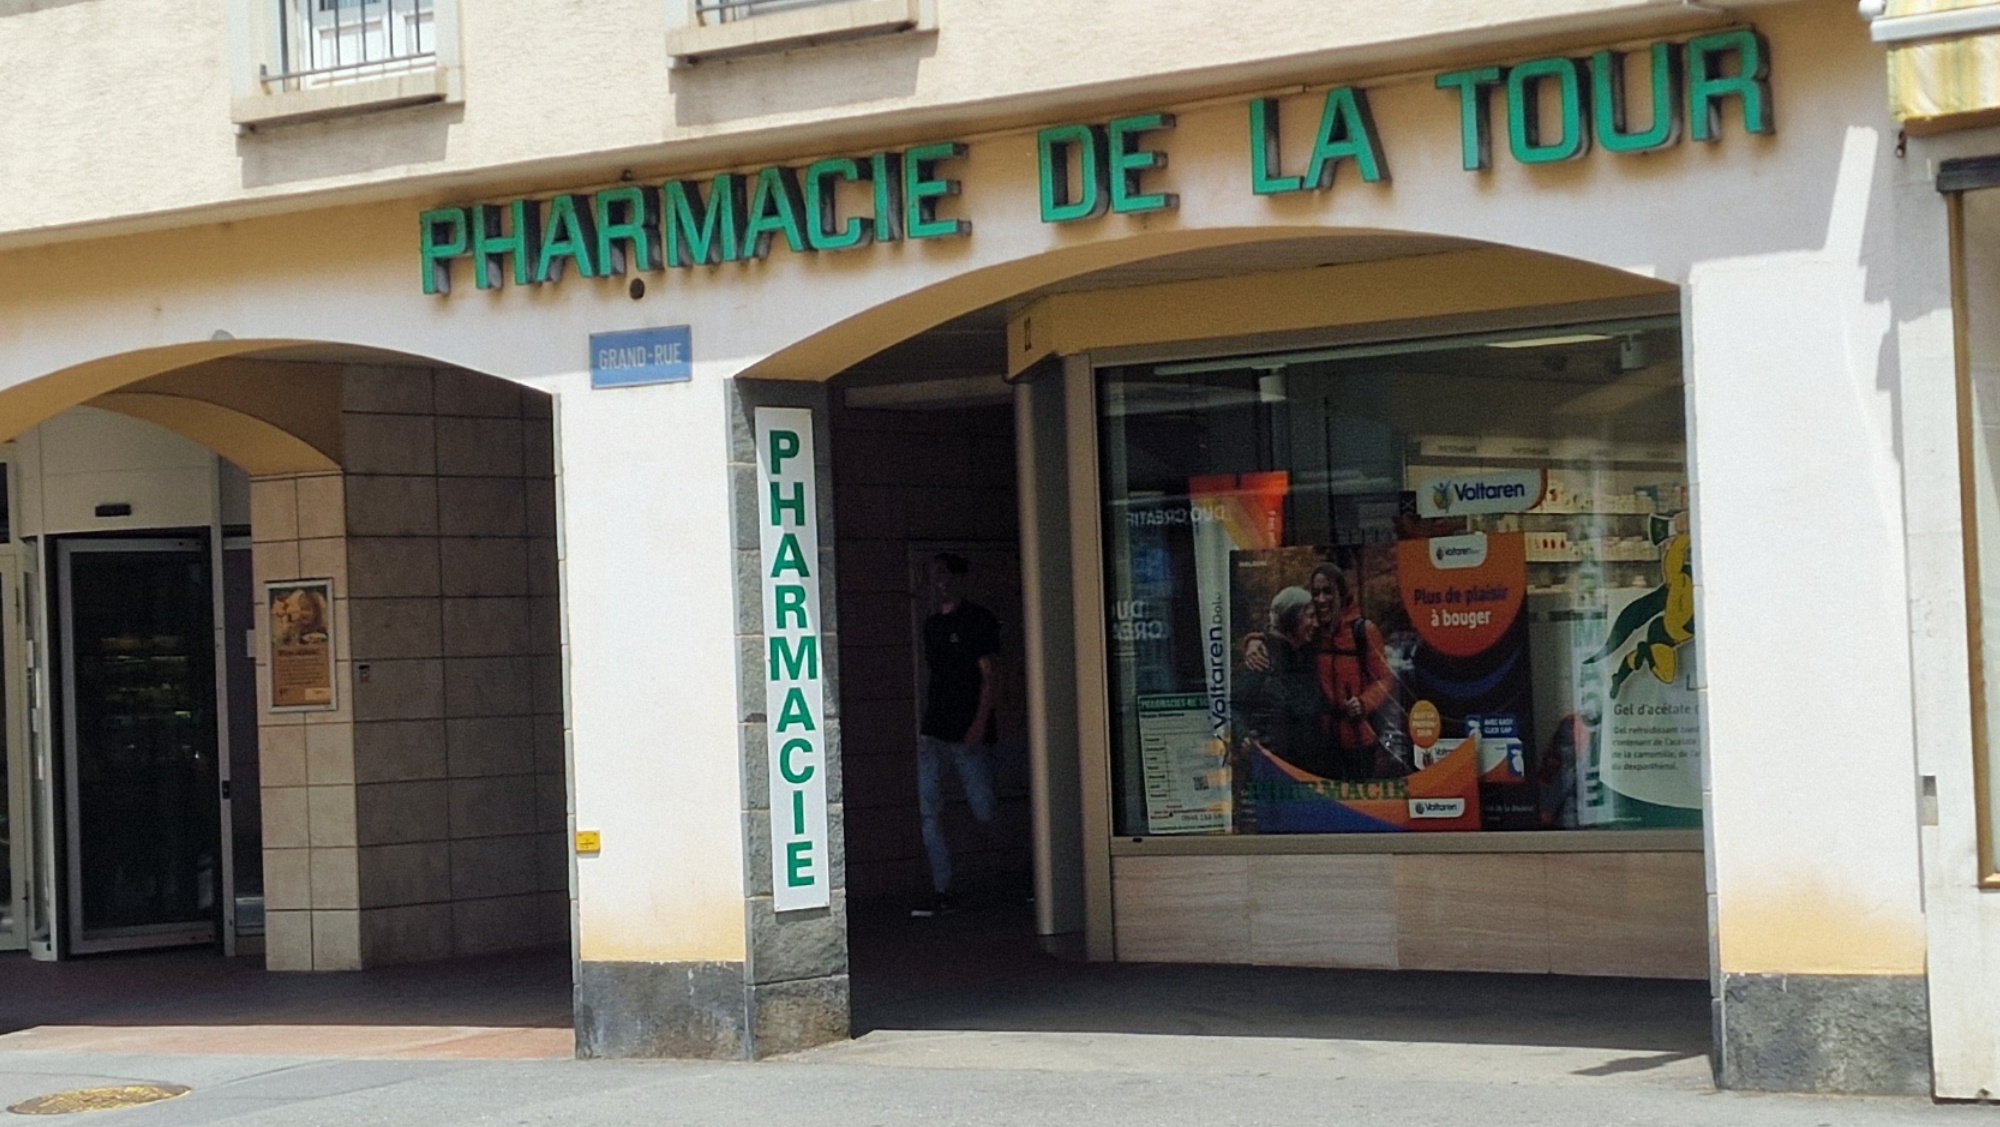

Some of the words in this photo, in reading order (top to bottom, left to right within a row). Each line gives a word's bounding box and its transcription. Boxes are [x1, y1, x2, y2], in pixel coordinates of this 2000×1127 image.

[419, 142, 968, 295] PHARMACIE
[1037, 114, 1178, 223] DE
[1249, 86, 1390, 196] LA
[1434, 30, 1774, 171] TOUR
[599, 342, 682, 371] GRAND-RUE
[1453, 482, 1525, 501] Voltaren
[1414, 588, 1441, 606] Plus
[1444, 585, 1461, 603] de
[1465, 583, 1509, 606] plaisir
[1430, 609, 1440, 627] à
[1442, 608, 1491, 630] bouger
[768, 429, 818, 888] PHARMACIE
[1209, 626, 1228, 729] Voltaren
[1613, 703, 1634, 716] Gel
[1637, 702, 1691, 716] d'acétate
[1424, 803, 1458, 812] Voltaren
